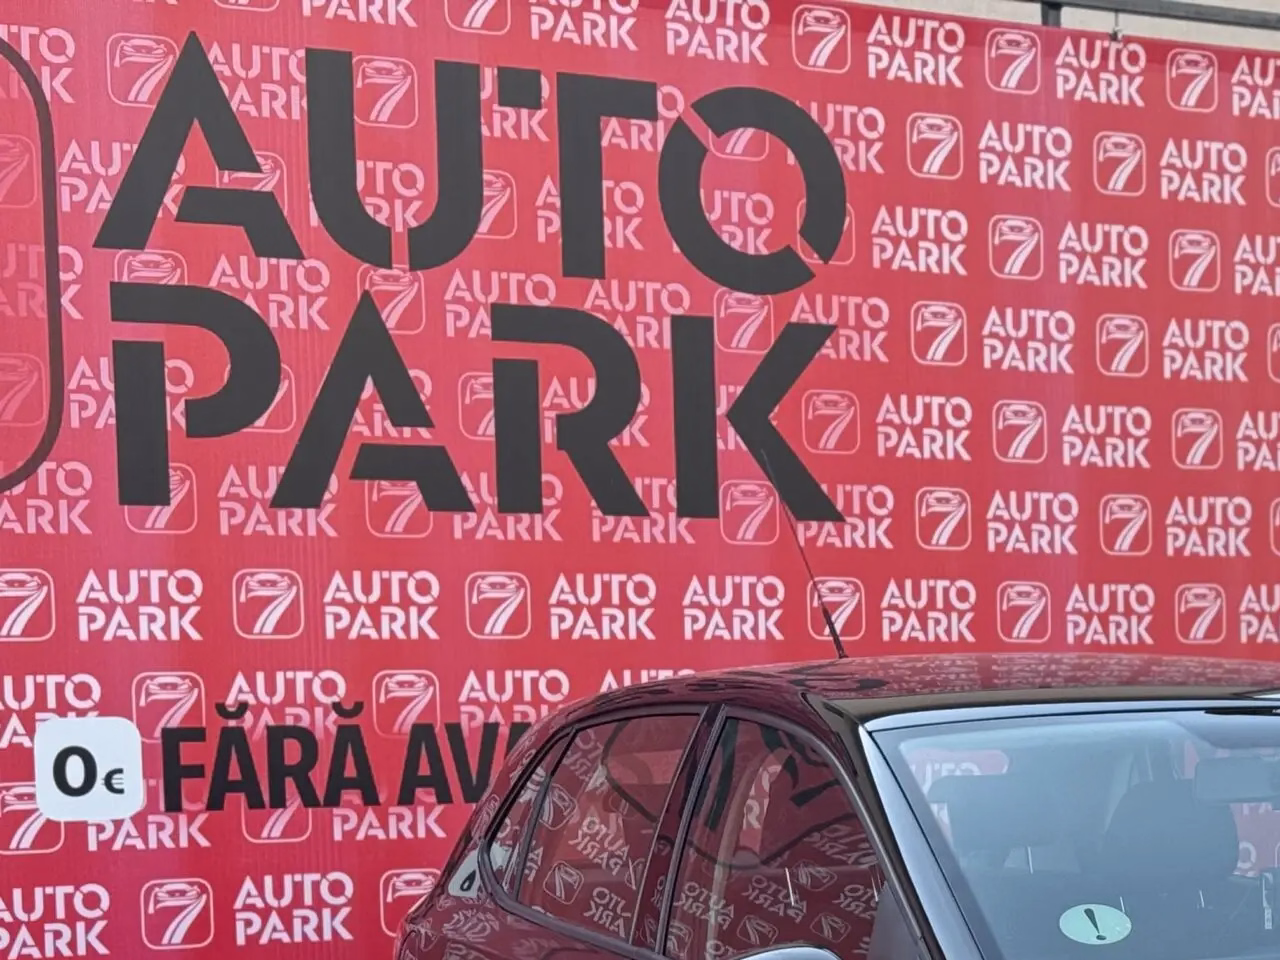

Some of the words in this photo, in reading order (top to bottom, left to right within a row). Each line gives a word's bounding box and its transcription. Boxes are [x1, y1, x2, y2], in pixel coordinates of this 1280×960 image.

[529, 6, 640, 51] PARK
[666, 21, 768, 65] PARK
[867, 14, 966, 54] AUTO
[868, 45, 963, 88] PARK
[1055, 36, 1146, 74] AUTO
[1056, 67, 1145, 107] PARK
[796, 100, 886, 140] UTO
[978, 120, 1072, 159] AUTO
[1160, 138, 1248, 173] AUTO
[92, 30, 848, 297] AUTO
[979, 152, 1071, 192] PARK
[1161, 169, 1246, 206] PARK
[871, 205, 968, 242] AUTO
[1058, 221, 1149, 257] AUTO
[209, 254, 331, 294] AUTO
[872, 237, 967, 276] PARK
[1059, 252, 1147, 289] PARK
[444, 267, 556, 307] AUTO
[584, 279, 691, 316] AUTO
[982, 306, 1075, 342] AUTO
[1162, 318, 1249, 351] AUTO
[983, 337, 1074, 374] PARK
[1163, 348, 1248, 382] PARK
[109, 281, 847, 522] PARK
[876, 394, 972, 428] AUTO
[1061, 404, 1152, 437] AUTO
[877, 426, 971, 461] PARK
[1062, 434, 1150, 468] PARK
[819, 484, 894, 517] UTO
[986, 490, 1079, 523] AUTO
[1165, 496, 1252, 526] AUTO
[218, 501, 339, 538] PARK
[453, 507, 564, 541] PARK
[797, 519, 893, 549] PARK
[988, 521, 1078, 555] PARK
[1167, 526, 1251, 557] PARK
[76, 569, 203, 604] AUTO
[323, 570, 440, 604] AUTO
[549, 573, 656, 606] AUTO
[682, 575, 785, 607] AUTO
[880, 578, 976, 610] AUTO
[1065, 584, 1155, 613] AUTO
[78, 605, 203, 641] PARK
[325, 605, 439, 640] PARK
[550, 607, 656, 640] PARK
[684, 608, 784, 640] PARK
[882, 610, 975, 642] PARK
[1067, 614, 1153, 644] PARK
[0, 673, 101, 710] UTO
[226, 670, 348, 707] AUTO
[458, 668, 569, 704] AUTO
[161, 701, 380, 813] FĂRĂ
[400, 722, 534, 806] AV
[88, 812, 212, 852] PARK
[333, 806, 447, 841] PARK
[234, 872, 353, 909] AUTO
[236, 907, 353, 945] PARK
